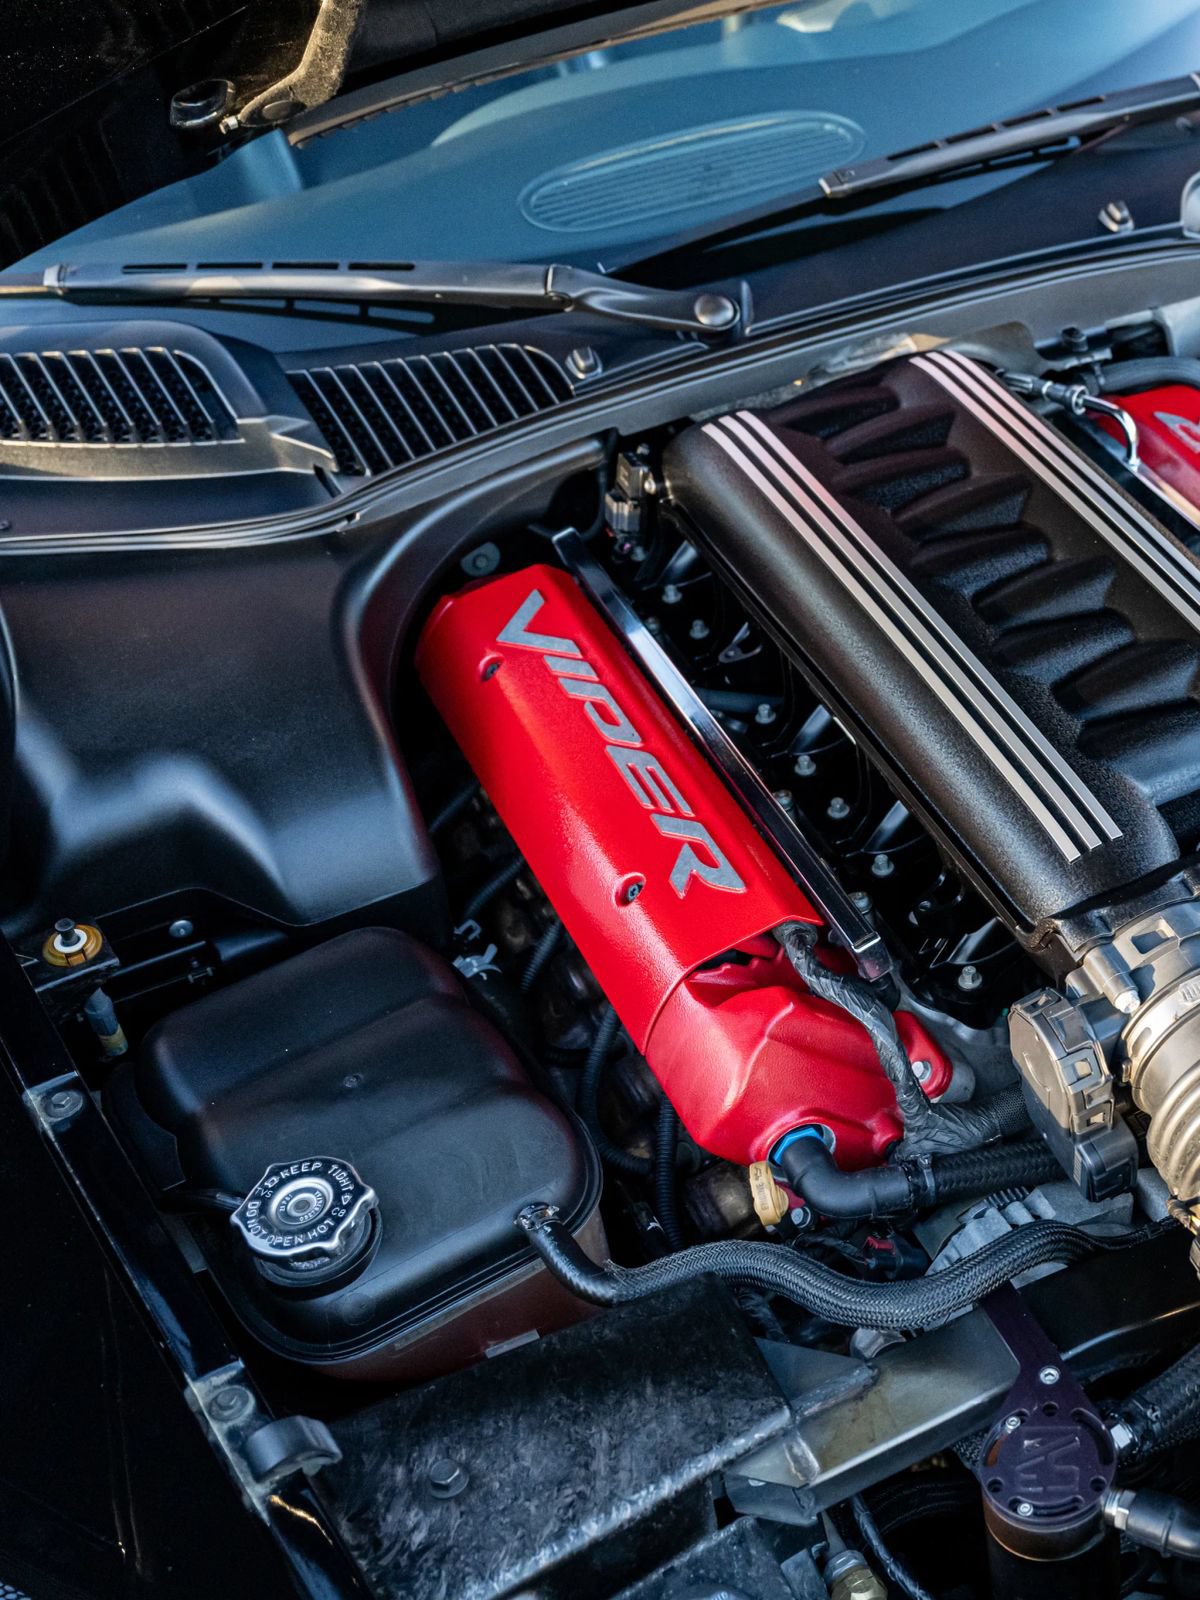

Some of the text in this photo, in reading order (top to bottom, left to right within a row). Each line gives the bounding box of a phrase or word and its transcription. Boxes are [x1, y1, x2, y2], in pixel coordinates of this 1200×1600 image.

[496, 589, 747, 899] VIPER
[280, 1162, 322, 1179] KEEP
[266, 1234, 304, 1247] OPEN
[307, 1218, 335, 1240] HOT
